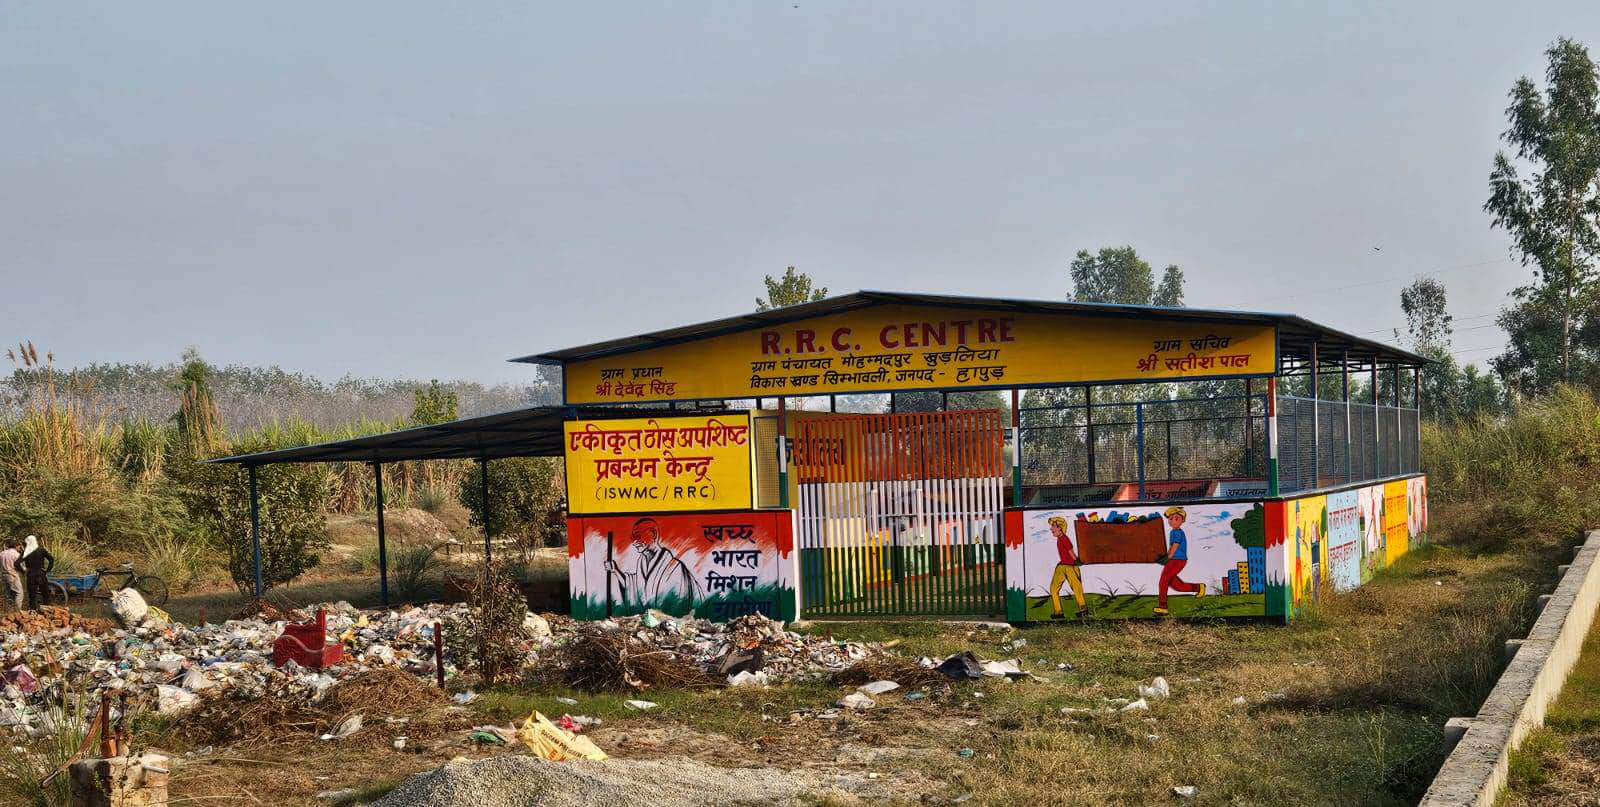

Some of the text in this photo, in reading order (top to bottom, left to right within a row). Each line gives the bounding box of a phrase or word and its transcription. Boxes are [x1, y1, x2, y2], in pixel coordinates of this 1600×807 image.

[761, 318, 1016, 355] R.R.C. CENTRE
[1152, 335, 1232, 353] ग्राम सचिव
[751, 361, 776, 372] ग्राम
[781, 358, 833, 369] पंचायत
[841, 353, 913, 368] मोहम्मदपुर
[1136, 353, 1252, 372] श्री सतीश पाल
[600, 367, 664, 380] ग्राम प्रधान
[750, 375, 786, 389] विकास
[790, 374, 819, 386] खण्ड
[896, 368, 936, 382] जनपद
[956, 366, 1008, 383] हापुड़
[595, 381, 612, 396] श्री
[648, 379, 678, 396] सिंह
[569, 418, 749, 455] एकीकृत ठोस अपशिष्ट
[594, 450, 714, 483] प्रबन्धन केन्द्र
[711, 550, 762, 569] भारत
[705, 570, 758, 593] मिशन
